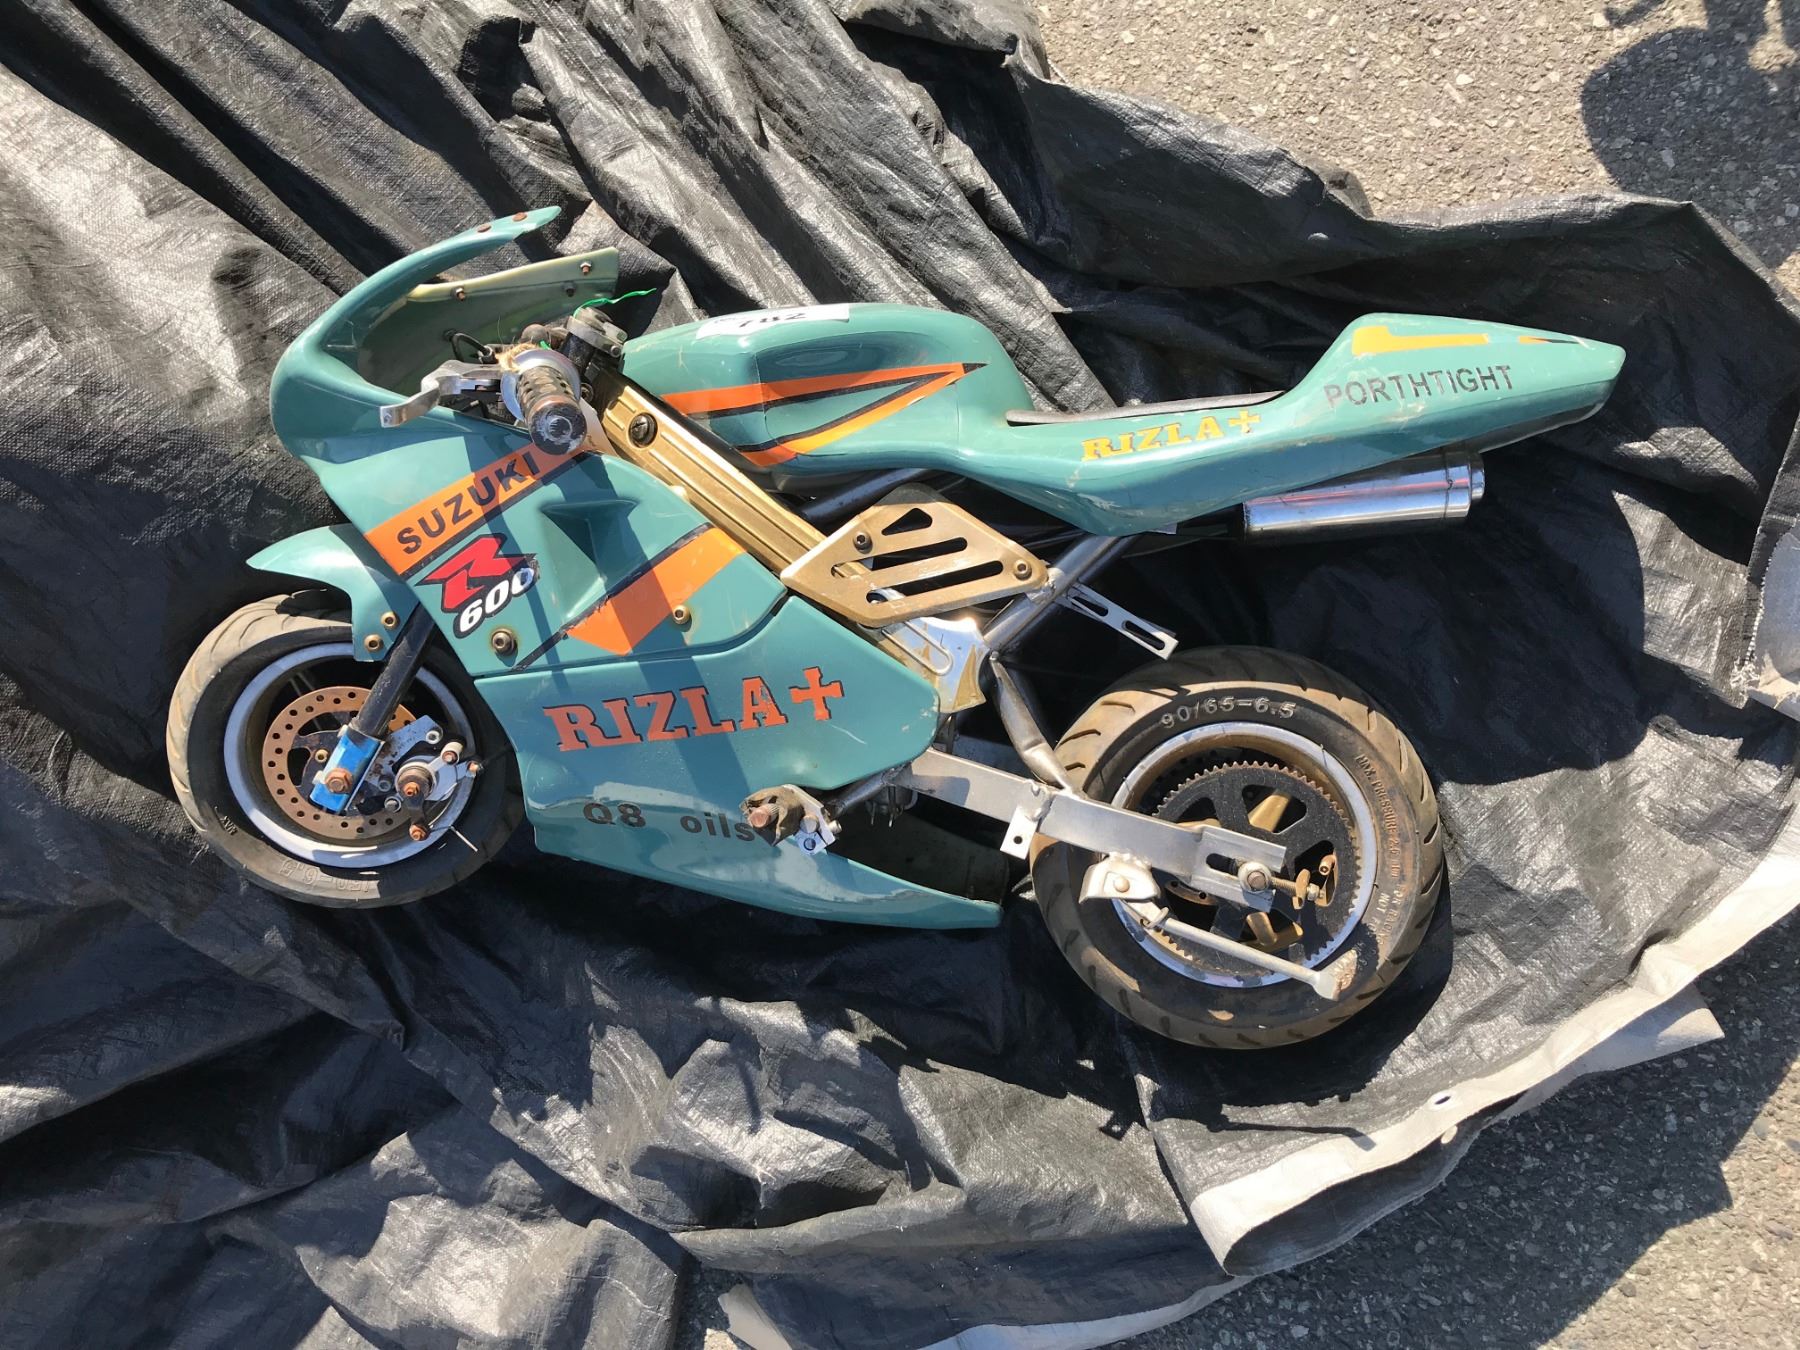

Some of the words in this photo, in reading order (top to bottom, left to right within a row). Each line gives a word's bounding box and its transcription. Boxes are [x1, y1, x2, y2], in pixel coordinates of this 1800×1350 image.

[1324, 365, 1513, 407] PORTHTIGHT
[1081, 409, 1260, 462] RIZLA+
[397, 452, 540, 554] SUZUKI
[455, 566, 538, 636] 600
[543, 666, 844, 751] RIZLA+
[1161, 695, 1297, 729] 90/65-6.5
[582, 802, 647, 828] Q8
[680, 811, 755, 842] oils
